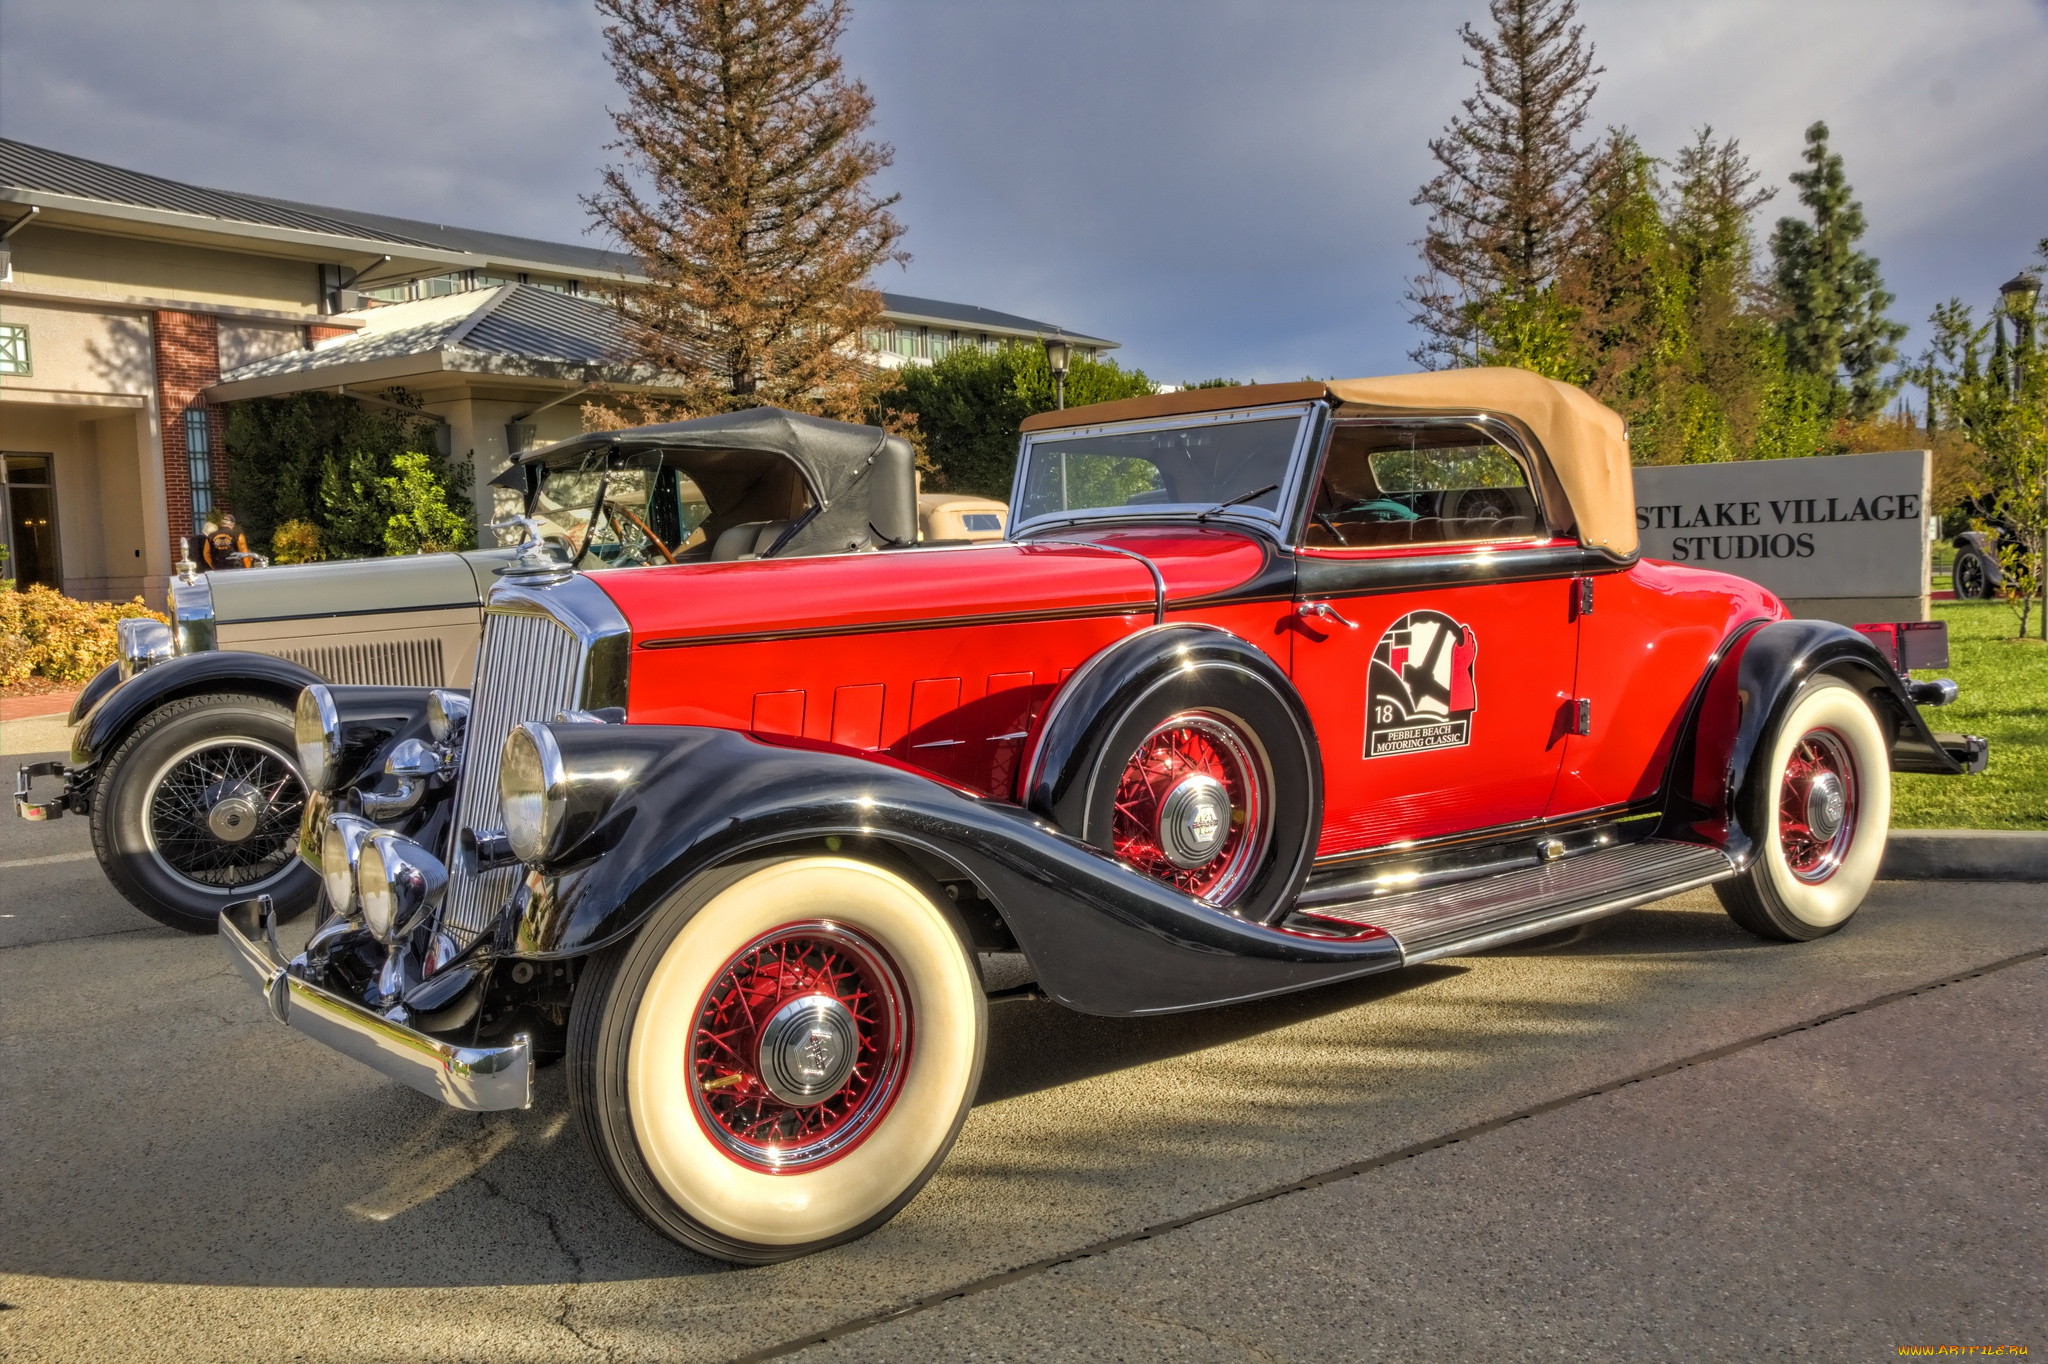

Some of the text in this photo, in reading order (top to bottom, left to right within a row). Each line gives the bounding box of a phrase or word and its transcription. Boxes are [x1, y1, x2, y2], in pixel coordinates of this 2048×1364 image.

[1768, 493, 1920, 525] VILLAGE
[1672, 533, 1815, 561] STUDIOS
[1375, 704, 1393, 724] 18
[1376, 733, 1461, 752] MOTORING CLASSIC
[1387, 724, 1452, 742] PEBBLE BEACH
